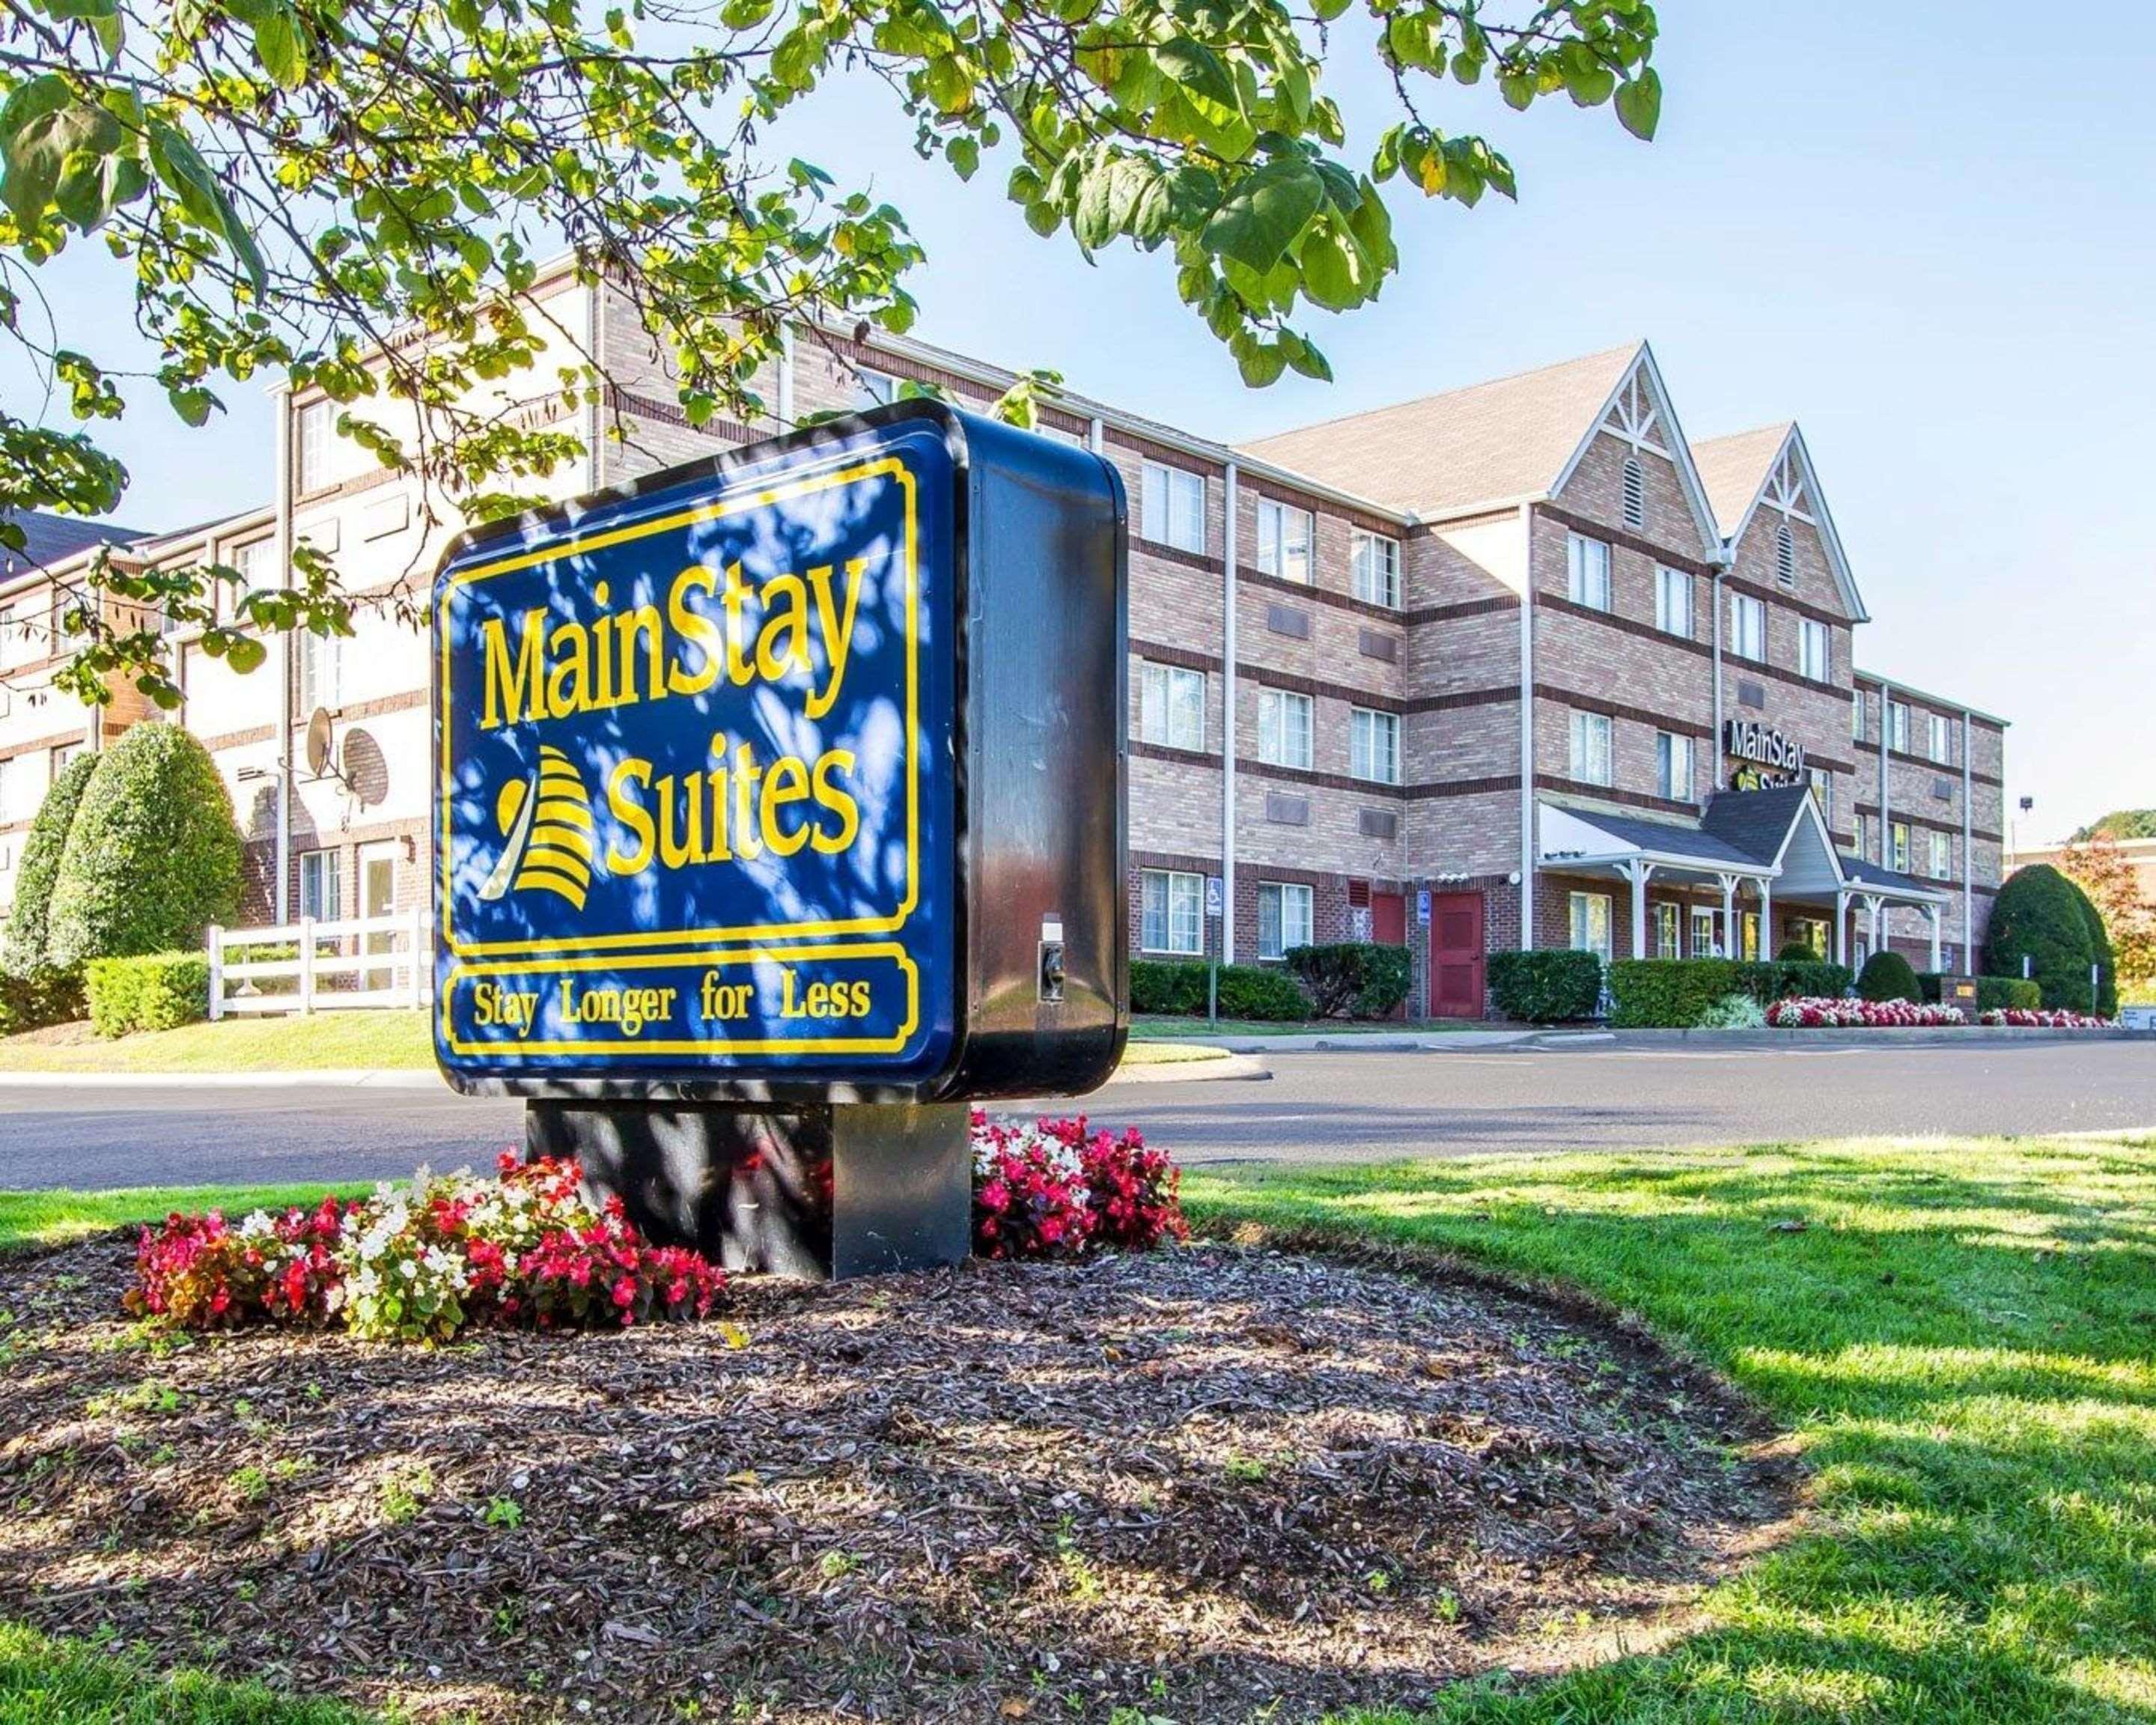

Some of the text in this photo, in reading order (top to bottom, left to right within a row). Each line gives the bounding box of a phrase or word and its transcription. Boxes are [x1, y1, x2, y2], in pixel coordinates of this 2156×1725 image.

[479, 558, 868, 730] MainStay
[1731, 719, 1805, 782] MainStay
[607, 733, 859, 875] Suites
[474, 970, 871, 1037] Stay Longer for Less
